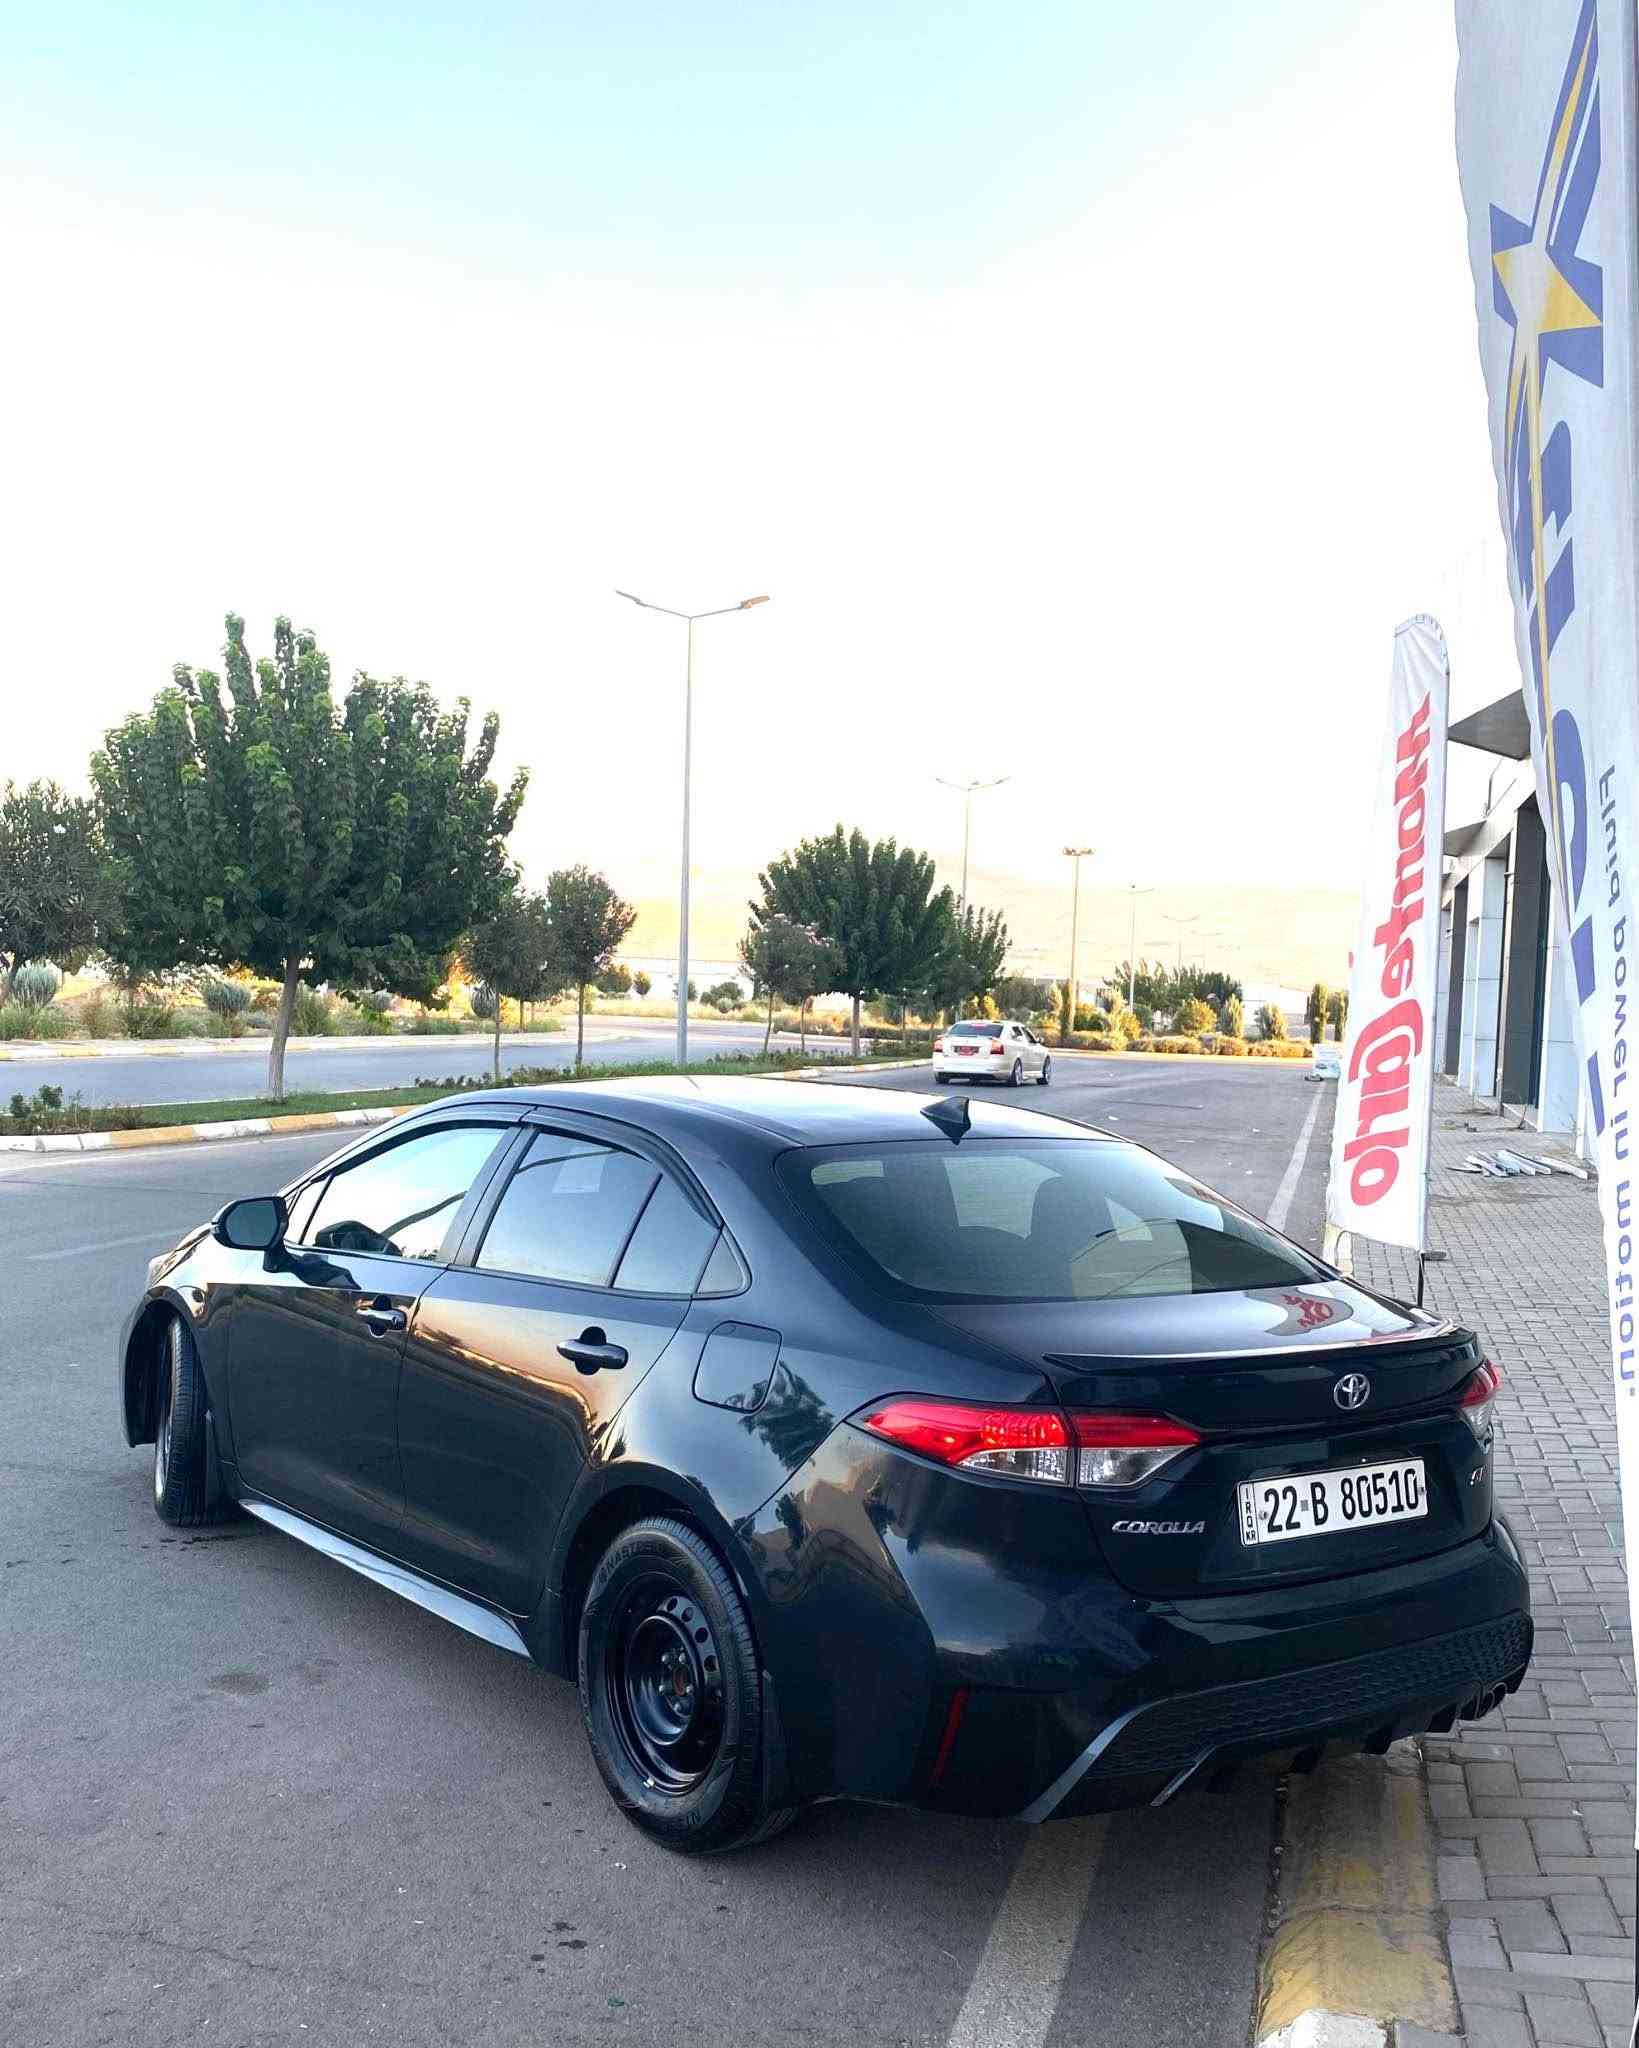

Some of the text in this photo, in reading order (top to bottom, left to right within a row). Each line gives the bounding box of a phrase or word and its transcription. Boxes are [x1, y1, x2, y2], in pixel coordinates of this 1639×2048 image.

[1264, 1467, 1419, 1533] 22 B 80510
[1111, 1520, 1205, 1535] COROLLA
